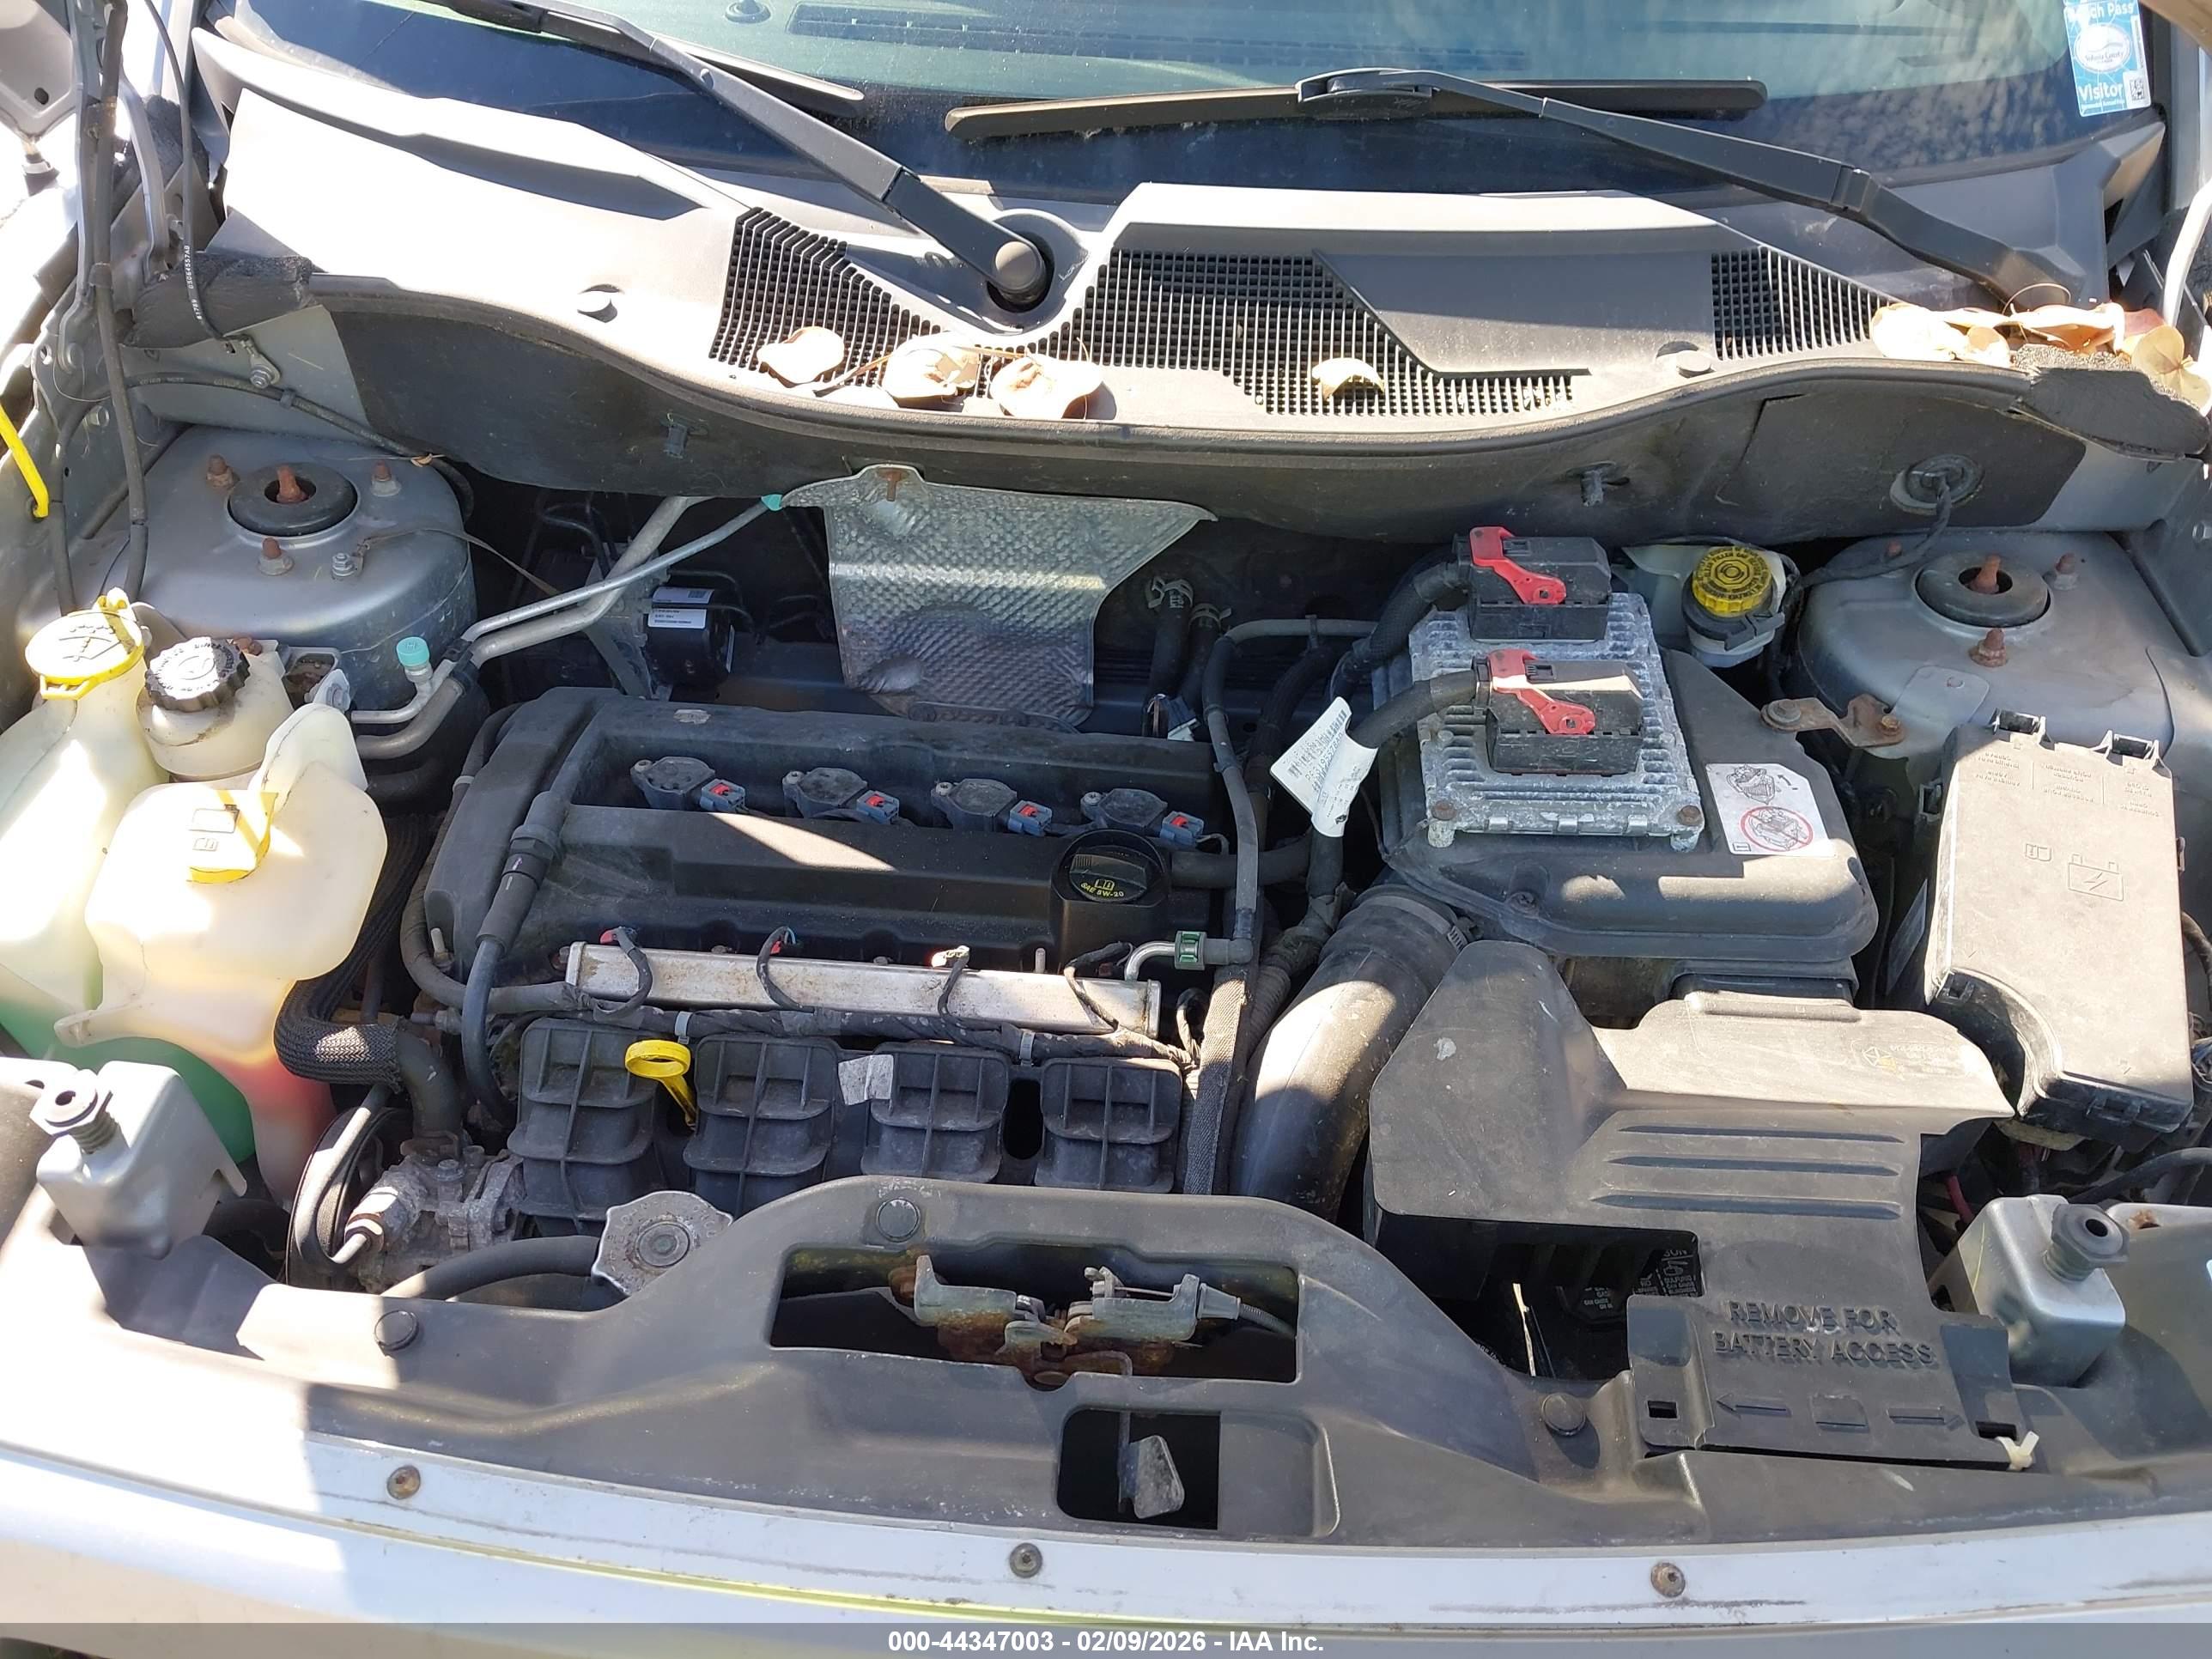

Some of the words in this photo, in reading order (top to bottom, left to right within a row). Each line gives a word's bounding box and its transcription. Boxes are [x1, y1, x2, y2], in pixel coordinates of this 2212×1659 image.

[2107, 3, 2134, 16] Pass
[2078, 82, 2124, 101] Visitor
[1080, 882, 1097, 893] SAE
[1097, 889, 1124, 897] 5W-20
[1728, 1300, 1836, 1330] REMOVE
[1843, 1306, 1898, 1332] FOR
[1713, 1331, 1817, 1359] BATTERY
[1830, 1339, 1934, 1366] ACCESS
